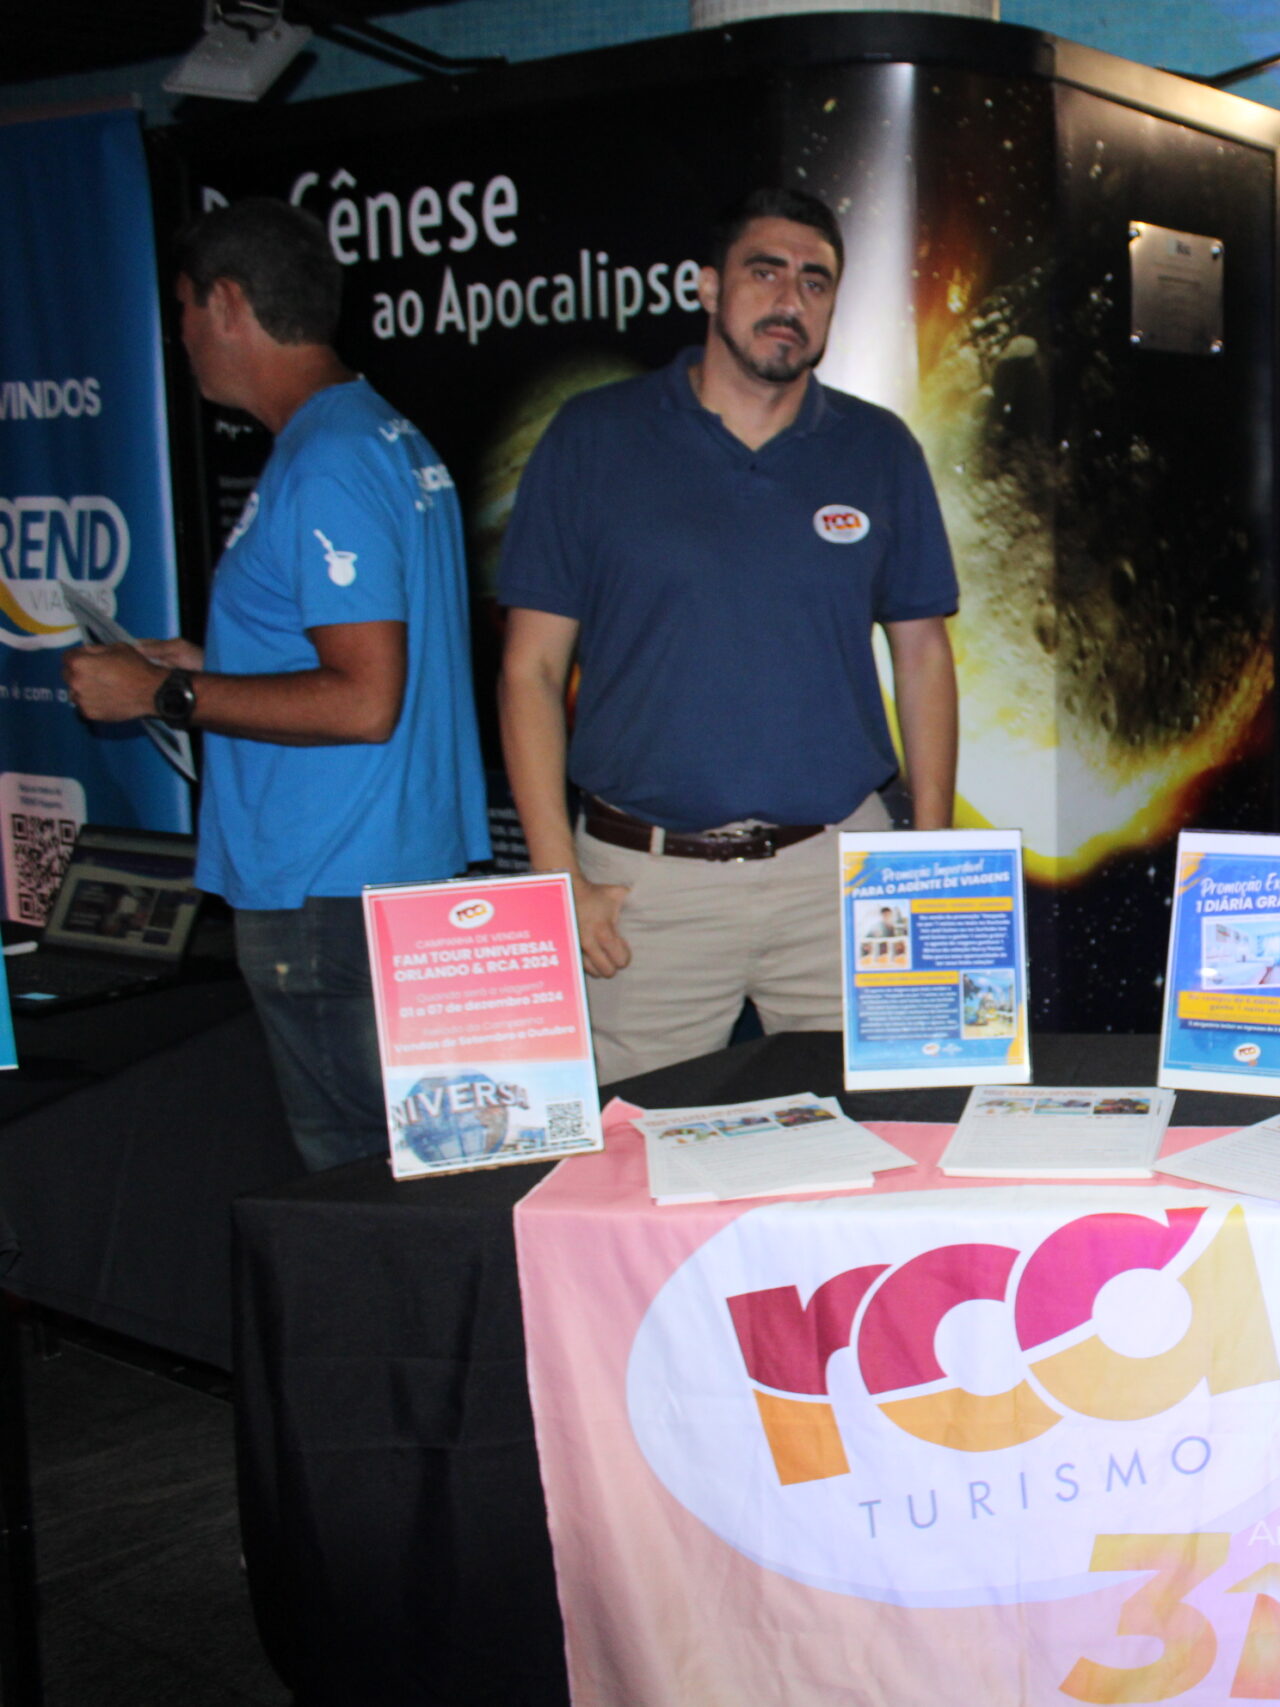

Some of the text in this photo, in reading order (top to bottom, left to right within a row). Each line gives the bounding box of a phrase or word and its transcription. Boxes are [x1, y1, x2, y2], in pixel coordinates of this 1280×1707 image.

[372, 249, 702, 344] ao Apocalipse
[852, 871, 1010, 898] PARA O AGENTE DE VIAGENS
[1201, 875, 1262, 898] Promoção
[1196, 900, 1202, 913] 1
[1204, 895, 1254, 913] DIÁRIA
[393, 940, 558, 968] FAM TOUR UNIVERSAL
[393, 954, 559, 983] ORLANDO & RCA 2024
[445, 1002, 463, 1013] de
[465, 995, 530, 1011] dezembro
[857, 1434, 1213, 1539] TURISMO
